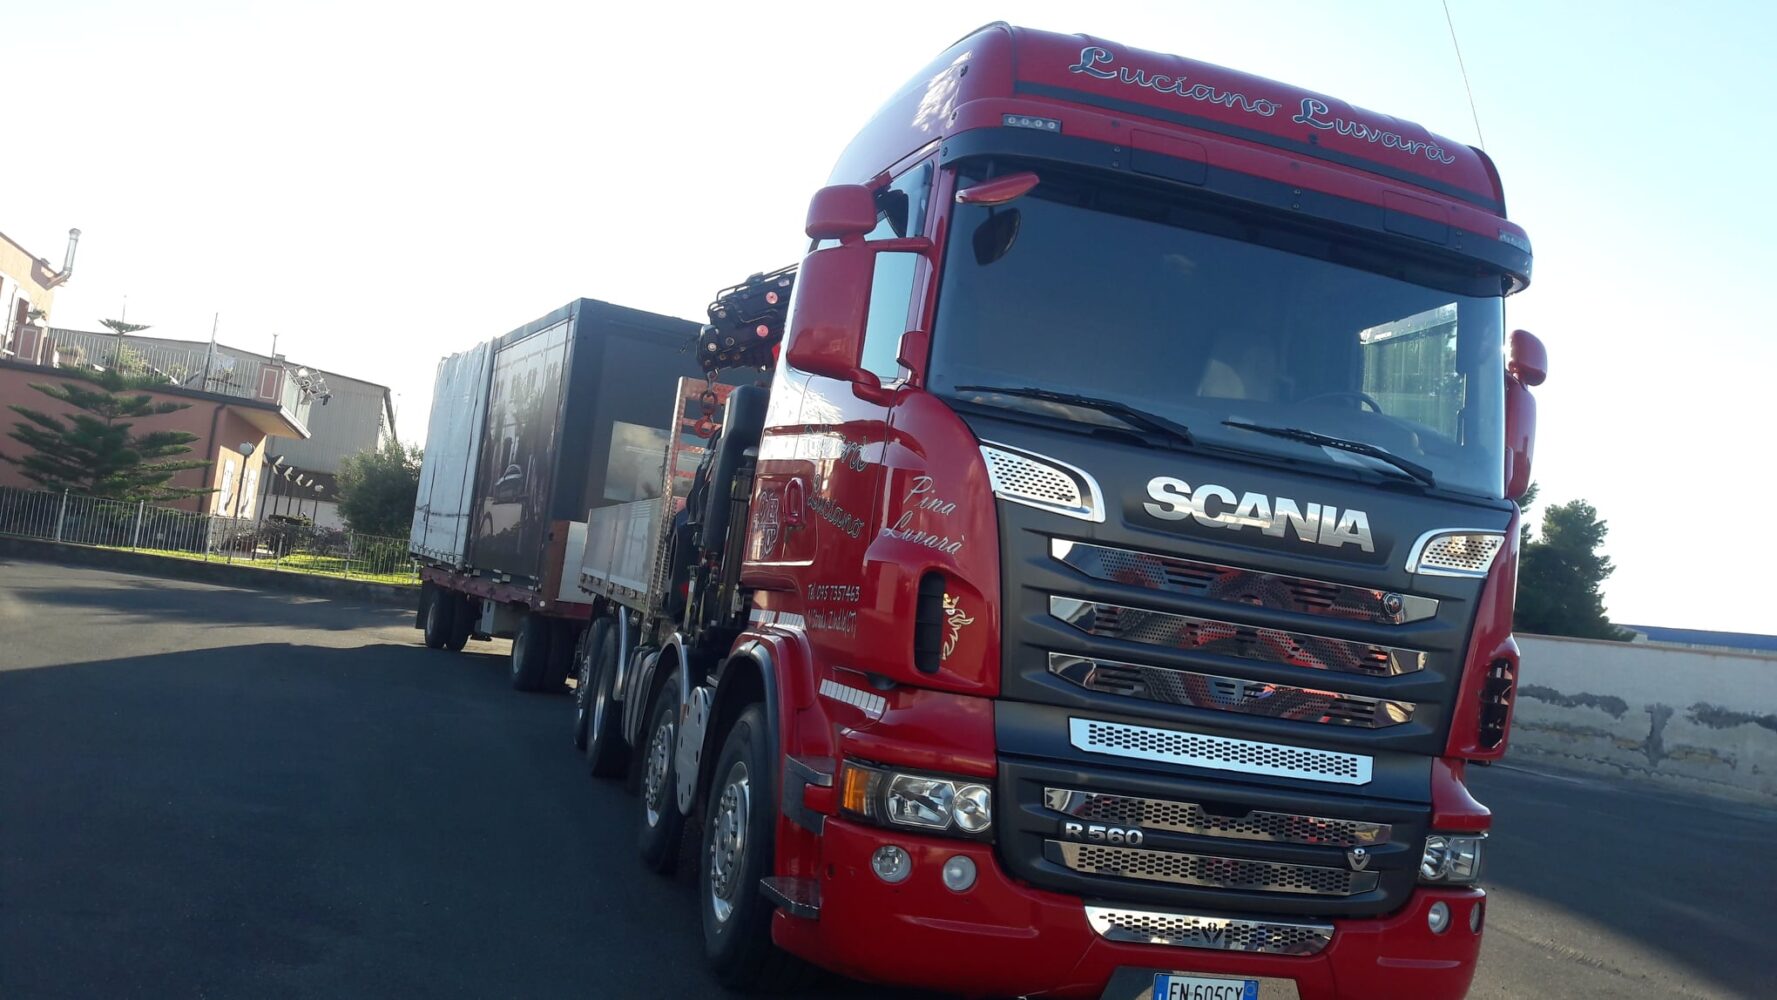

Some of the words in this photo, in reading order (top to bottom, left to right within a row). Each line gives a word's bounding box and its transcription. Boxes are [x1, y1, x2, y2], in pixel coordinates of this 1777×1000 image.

[1068, 46, 1281, 117] Luciano
[1292, 97, 1456, 164] Luvarà
[903, 475, 957, 516] Pina
[1142, 475, 1375, 553] SCANIA
[882, 509, 965, 555] Luvarà
[1065, 822, 1084, 839] R
[1088, 825, 1144, 845] 560
